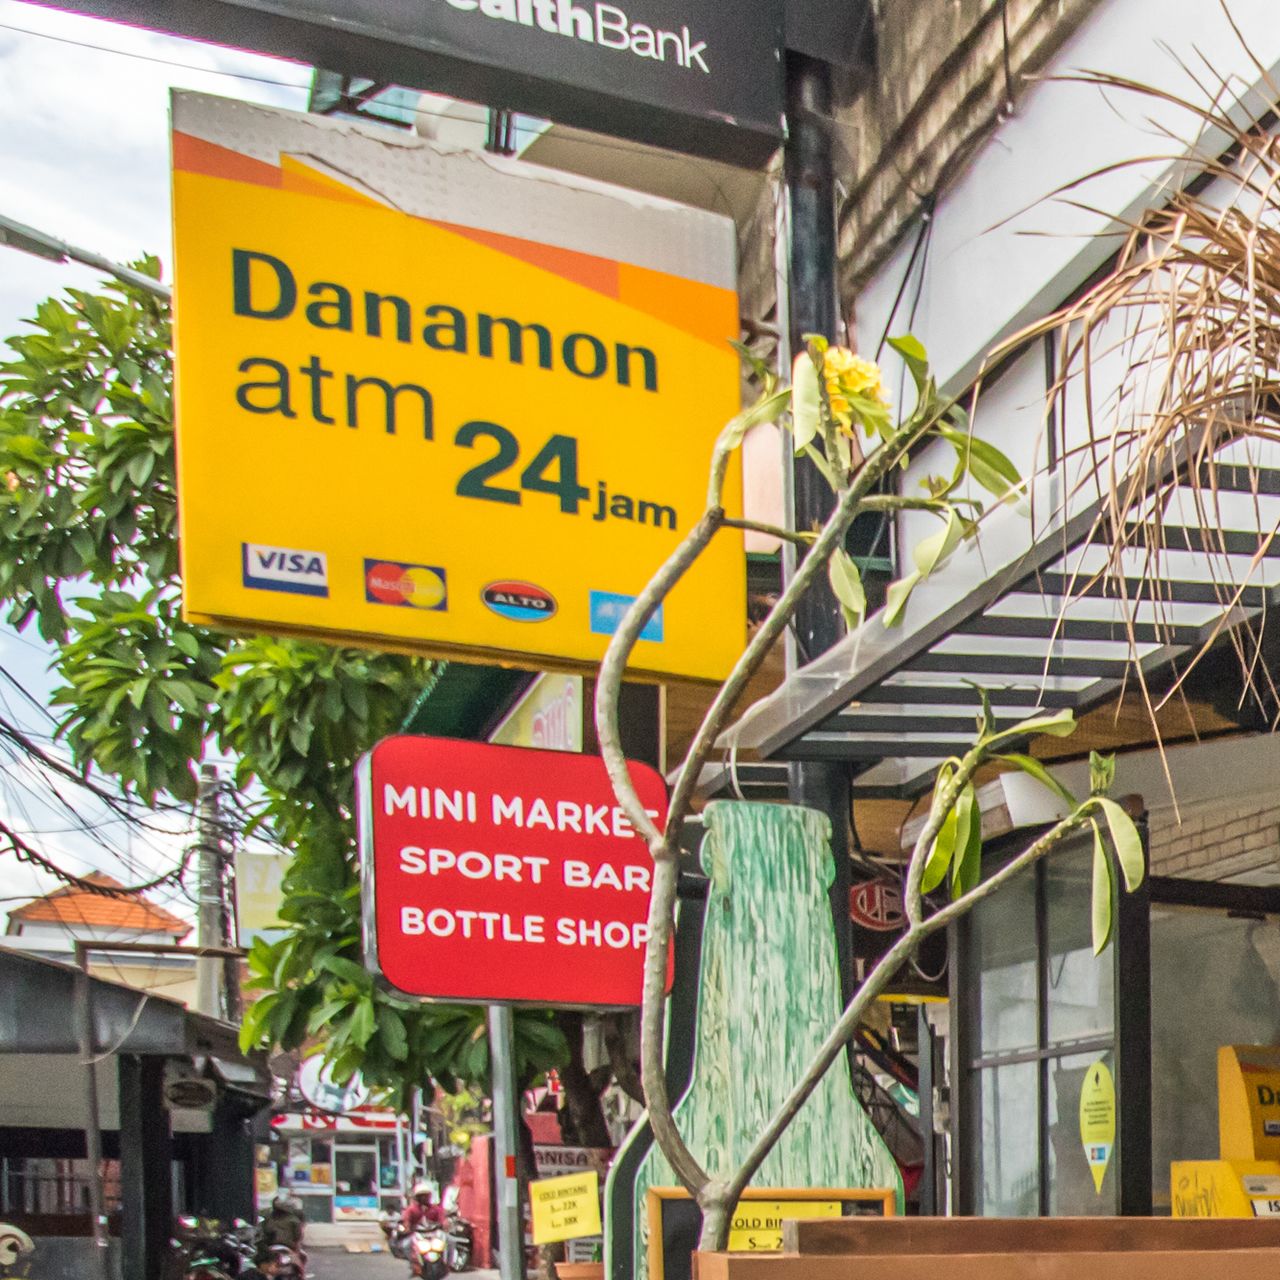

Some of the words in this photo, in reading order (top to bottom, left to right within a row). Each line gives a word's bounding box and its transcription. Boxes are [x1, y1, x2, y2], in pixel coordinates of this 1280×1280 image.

[231, 248, 660, 394] Danamon
[236, 352, 435, 442] atm
[453, 420, 589, 515] 24
[592, 481, 678, 531] jam
[257, 550, 325, 576] VISA
[494, 593, 547, 610] ALTO
[383, 783, 476, 823] MINI
[400, 846, 550, 884] SPORT
[563, 860, 650, 892] BAR
[401, 906, 545, 944] BOTTLE
[556, 917, 652, 950] SHOP
[735, 1217, 762, 1229] OLD
